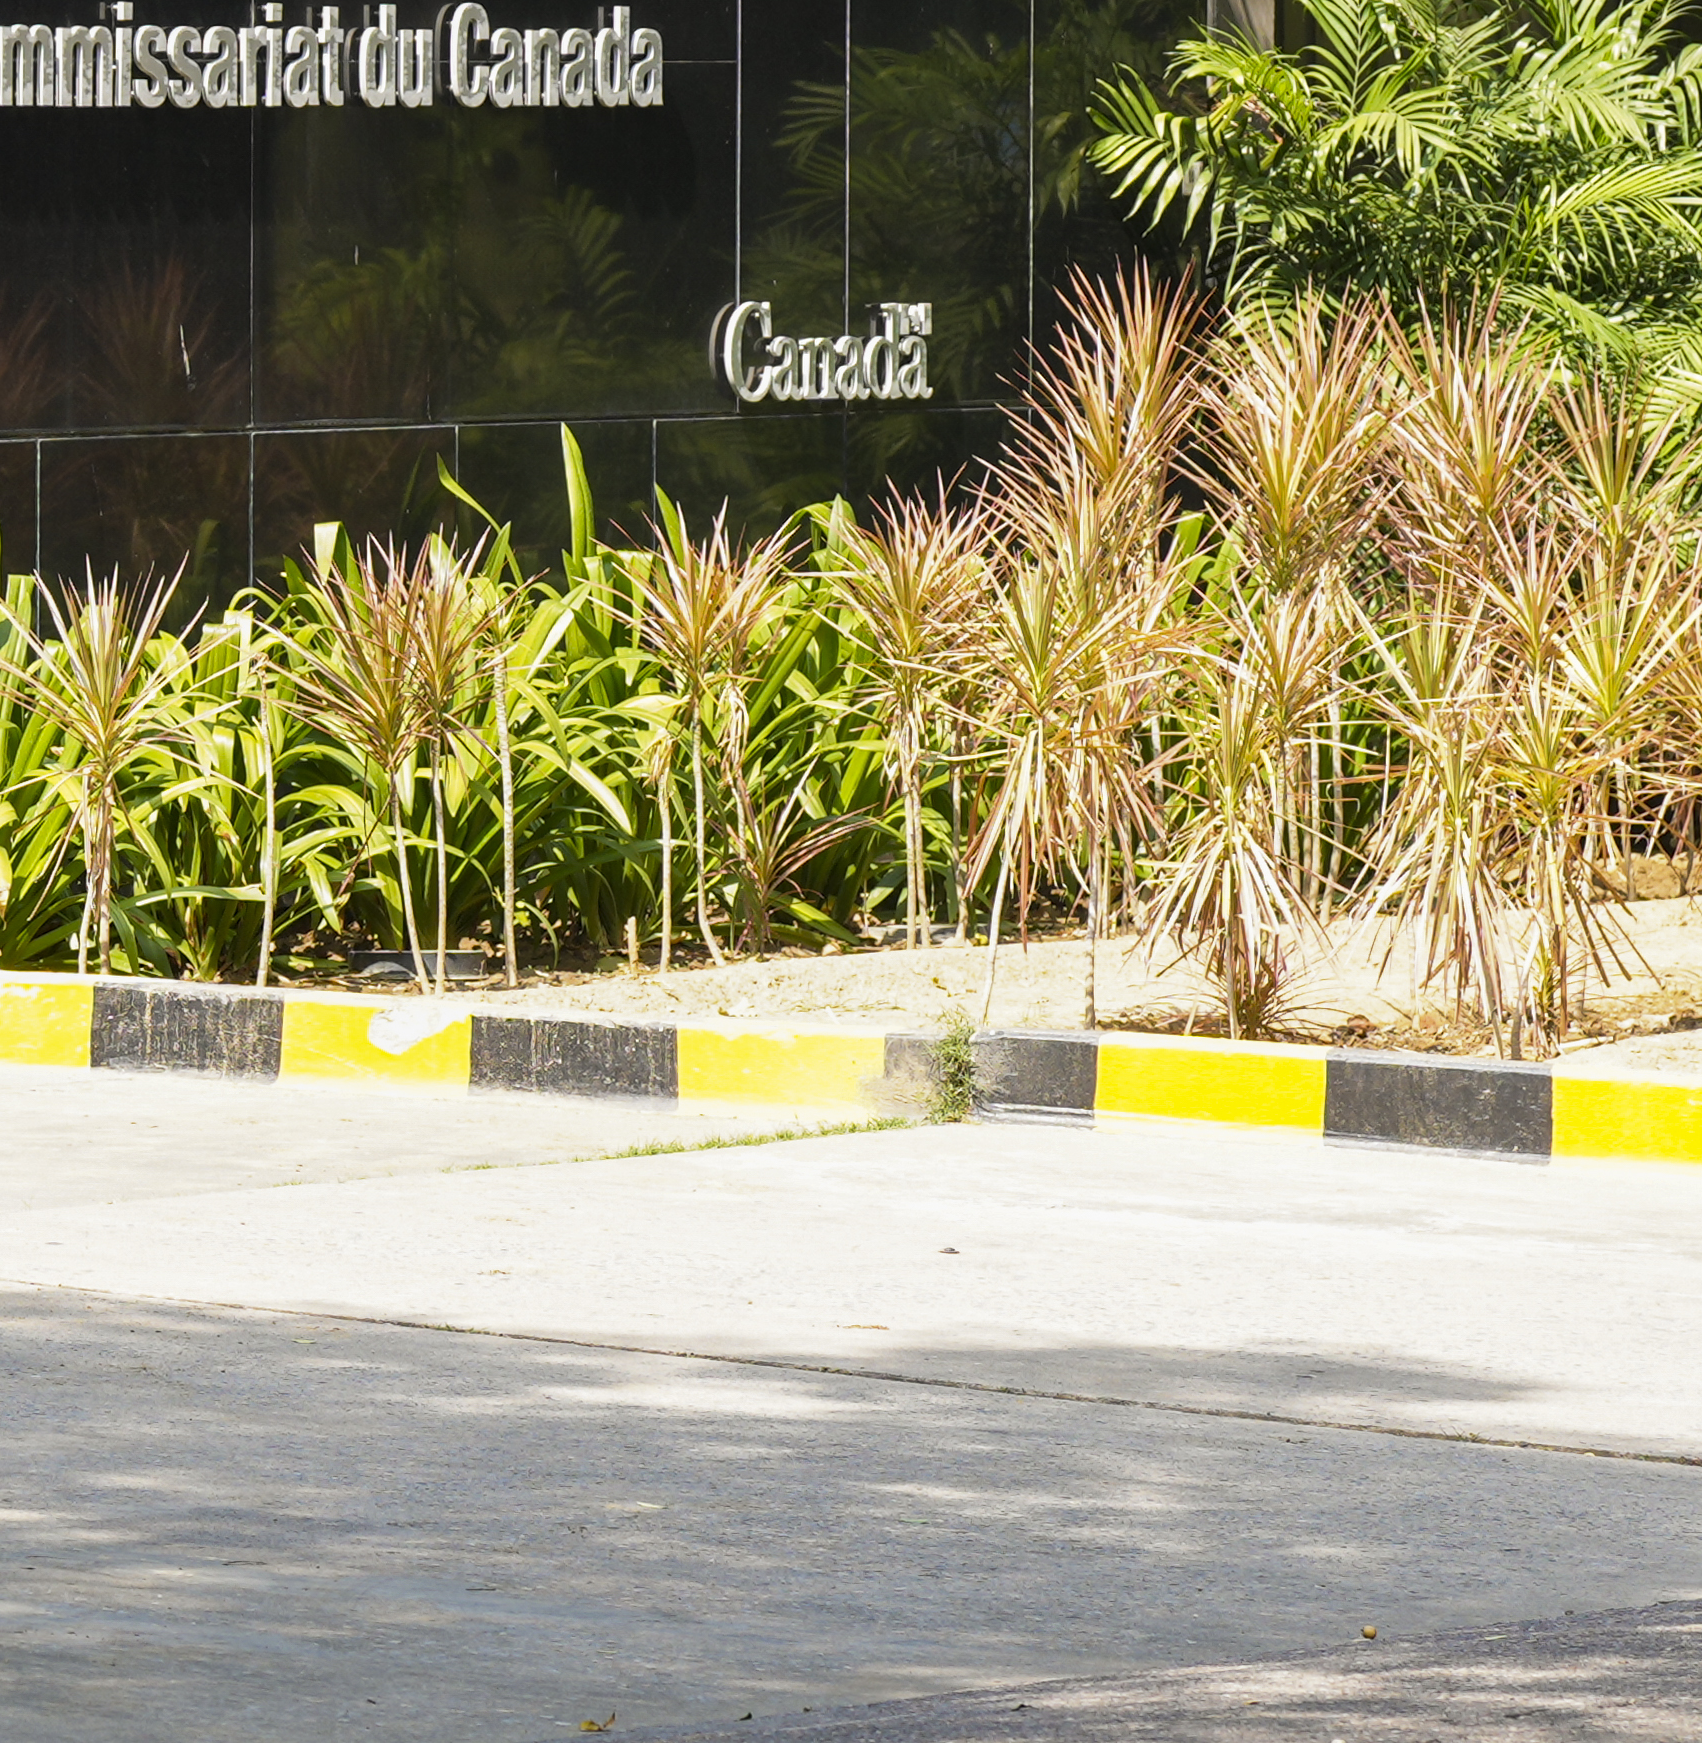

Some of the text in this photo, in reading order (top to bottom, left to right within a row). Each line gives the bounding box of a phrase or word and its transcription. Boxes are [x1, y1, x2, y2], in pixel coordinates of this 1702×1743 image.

[359, 3, 433, 108] du
[449, 2, 665, 108] Canada
[723, 300, 934, 403] Canada
